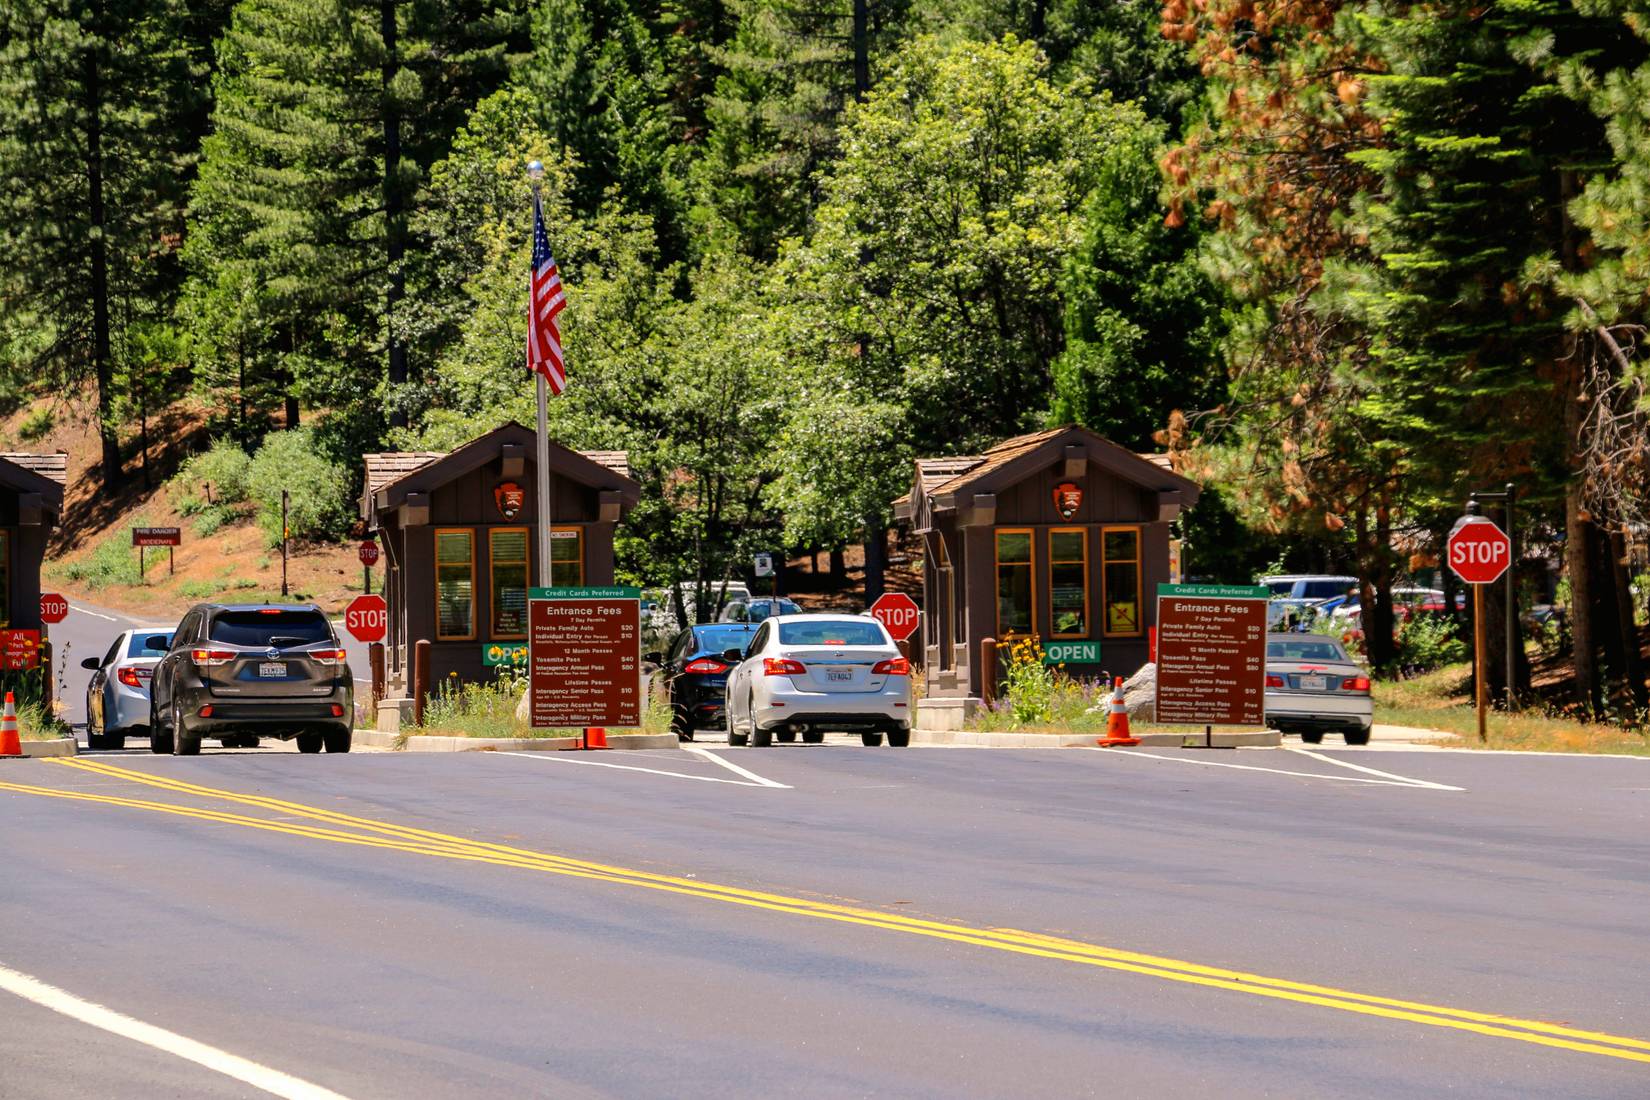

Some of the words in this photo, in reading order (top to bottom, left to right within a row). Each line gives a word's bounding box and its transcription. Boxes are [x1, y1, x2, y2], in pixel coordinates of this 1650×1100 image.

[360, 549, 377, 559] STOP
[1453, 541, 1506, 564] STOP
[40, 602, 67, 615] STOP
[547, 607, 593, 615] Entrance
[597, 606, 622, 615] Fees
[1174, 603, 1221, 613] Entrance
[1224, 605, 1249, 613] Fees
[875, 608, 916, 626] STOP
[1048, 645, 1096, 660] OPEN
